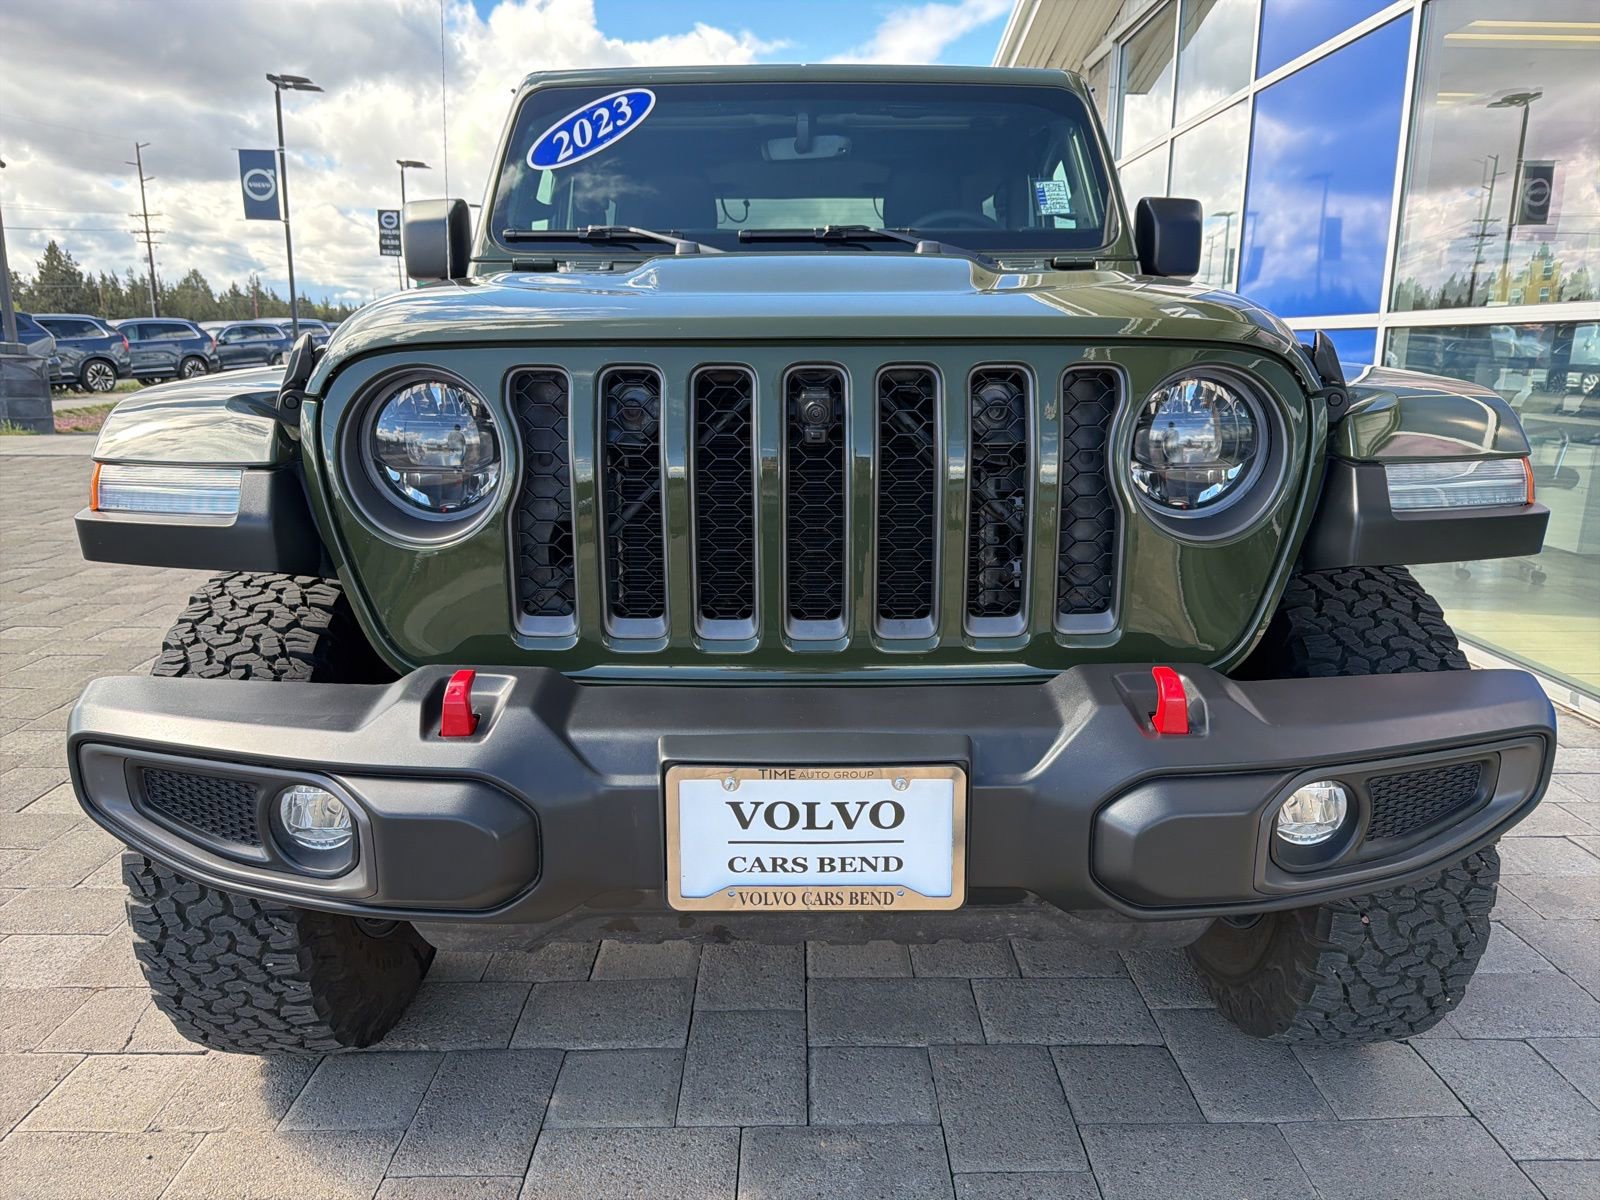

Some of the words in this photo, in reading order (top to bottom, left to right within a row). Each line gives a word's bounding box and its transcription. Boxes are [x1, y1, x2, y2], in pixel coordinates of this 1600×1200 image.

[553, 96, 632, 162] 2023
[758, 769, 796, 780] TIME
[798, 771, 830, 779] AUTO
[833, 771, 874, 779] GROUP
[725, 800, 905, 830] VOLVO
[728, 856, 809, 873] CARS
[816, 856, 903, 873] BEND
[738, 891, 796, 906] VOLVO
[801, 891, 844, 906] CARS
[848, 891, 895, 906] BEND
